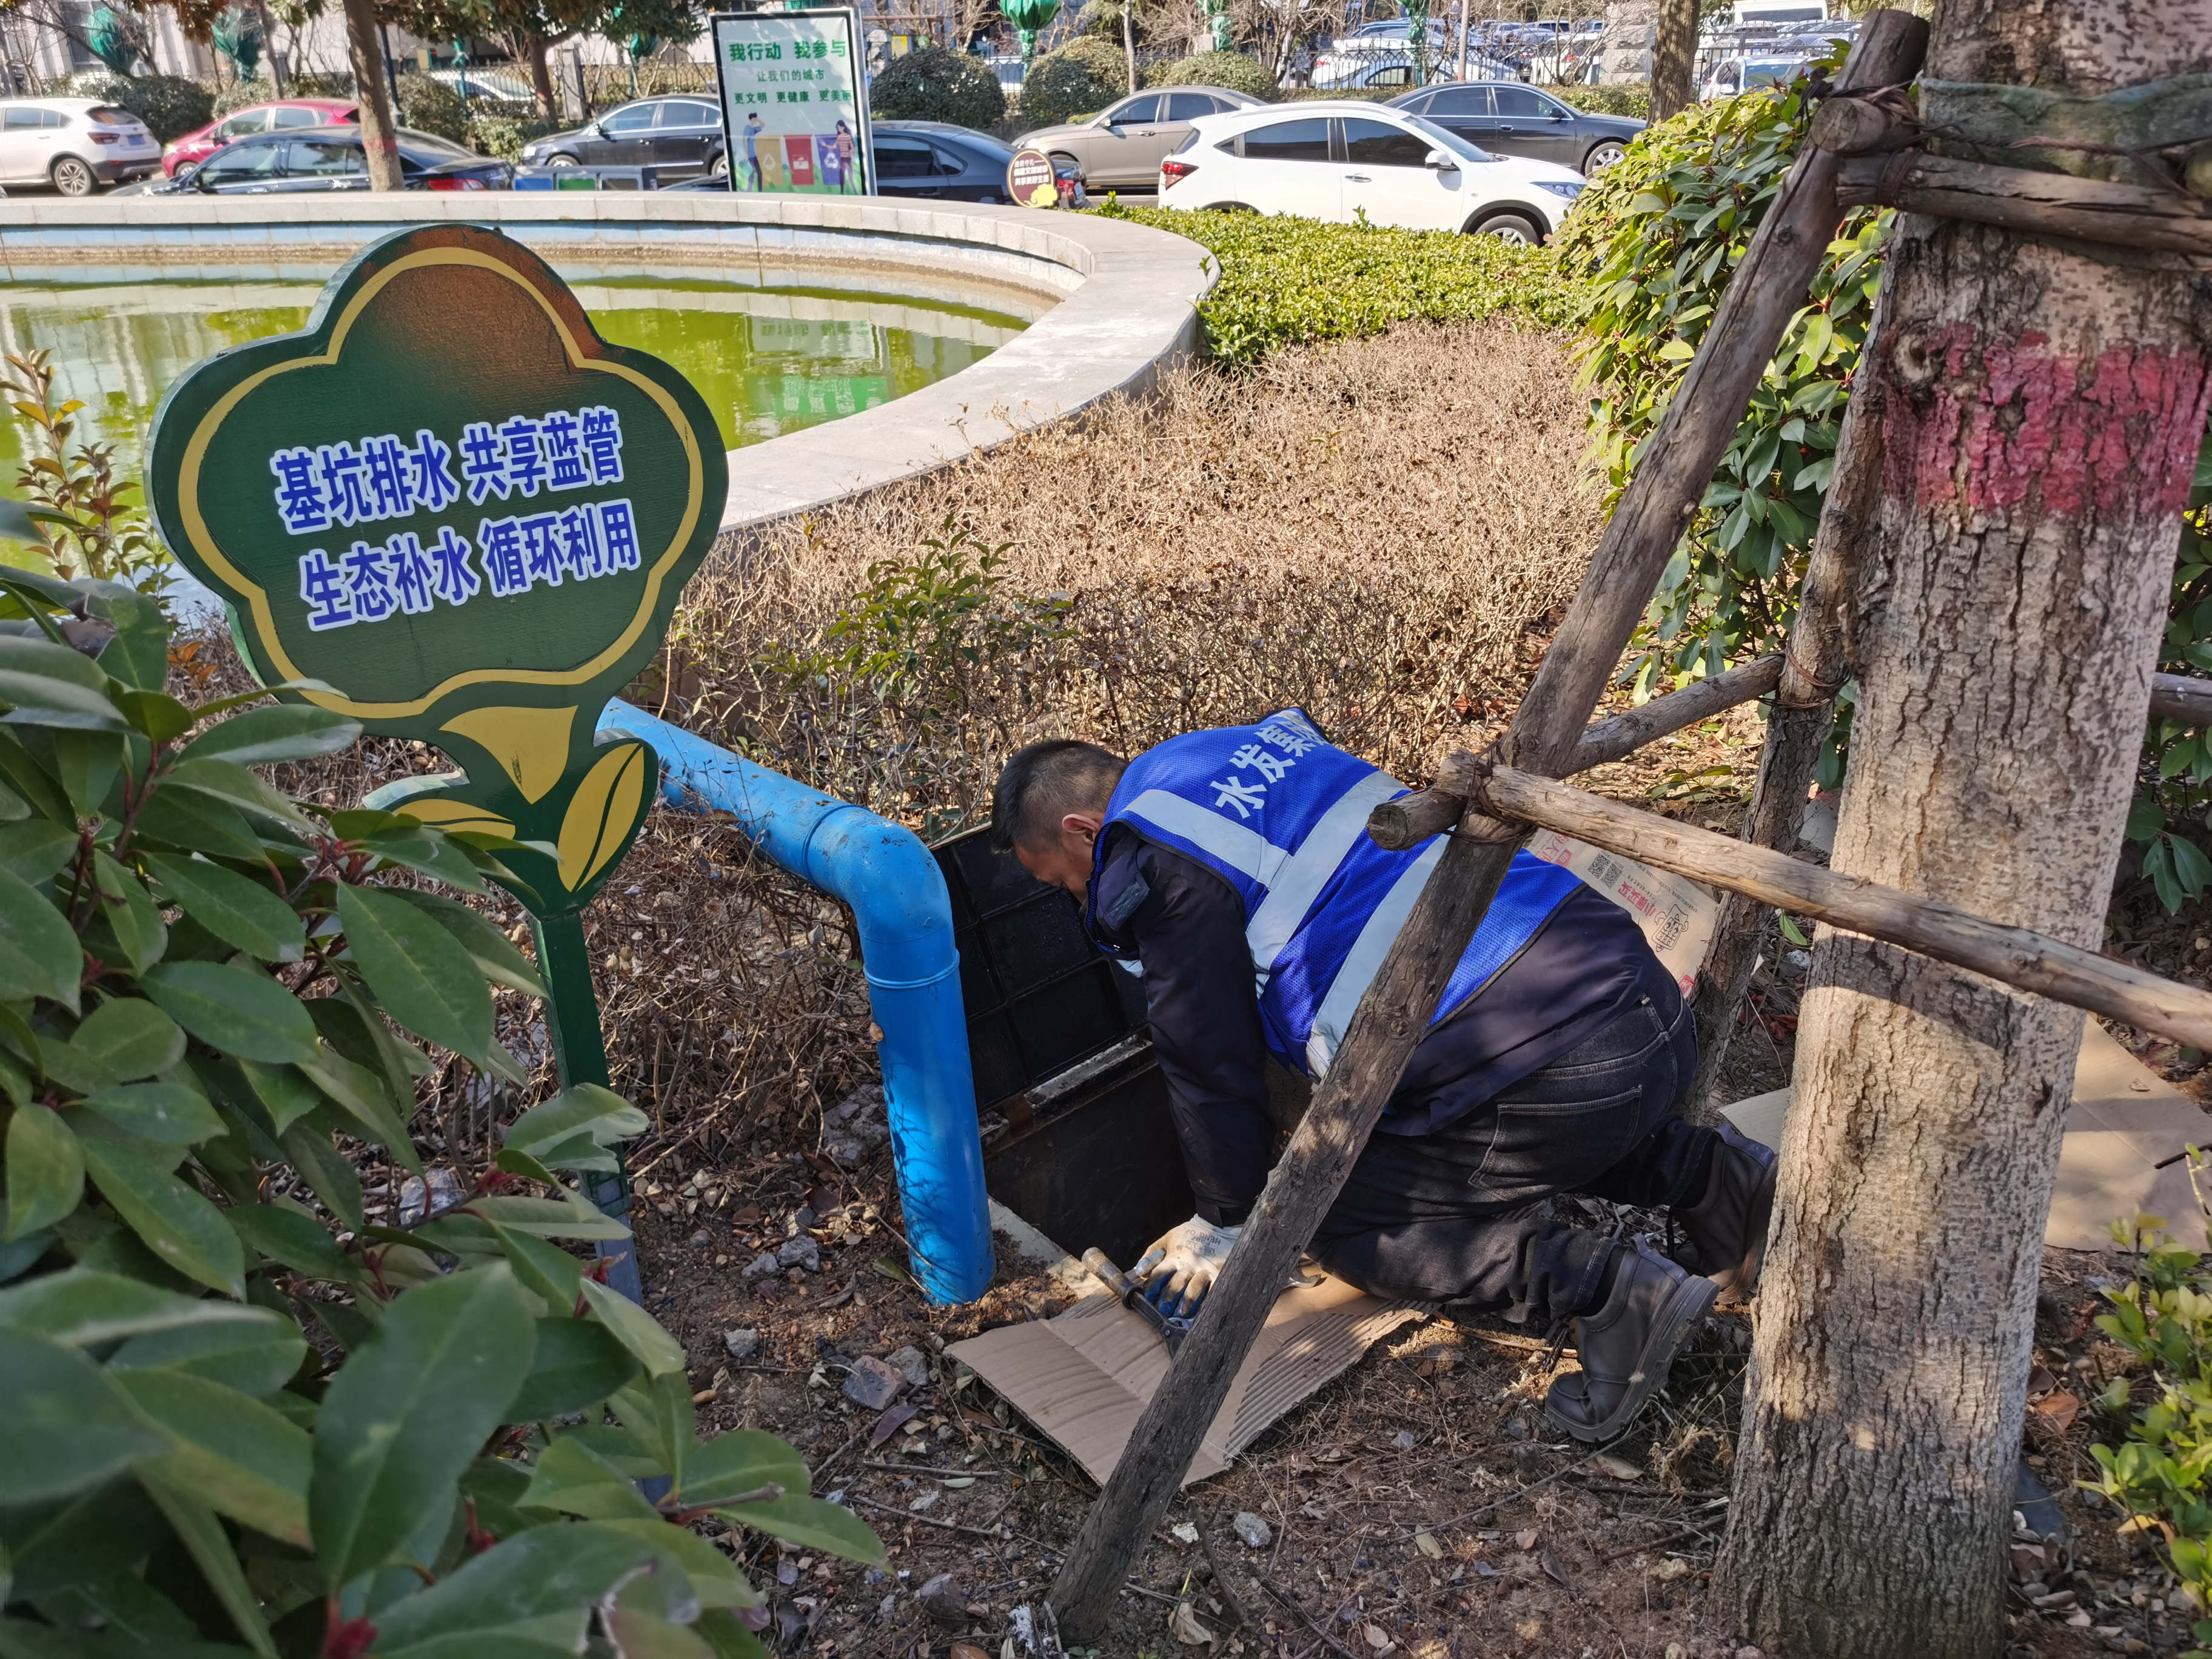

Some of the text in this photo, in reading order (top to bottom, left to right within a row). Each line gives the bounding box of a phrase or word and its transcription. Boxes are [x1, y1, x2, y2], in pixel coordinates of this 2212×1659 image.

[729, 39, 846, 61] 我行动 我参与
[757, 69, 825, 82] 让我们的城市
[734, 92, 768, 104] 更文明
[776, 91, 810, 103] 更健康
[273, 406, 623, 533] 基坑排水 共享蓝管
[302, 500, 639, 629] 生态补水 循环利用
[1199, 1232, 1222, 1245] HENG
